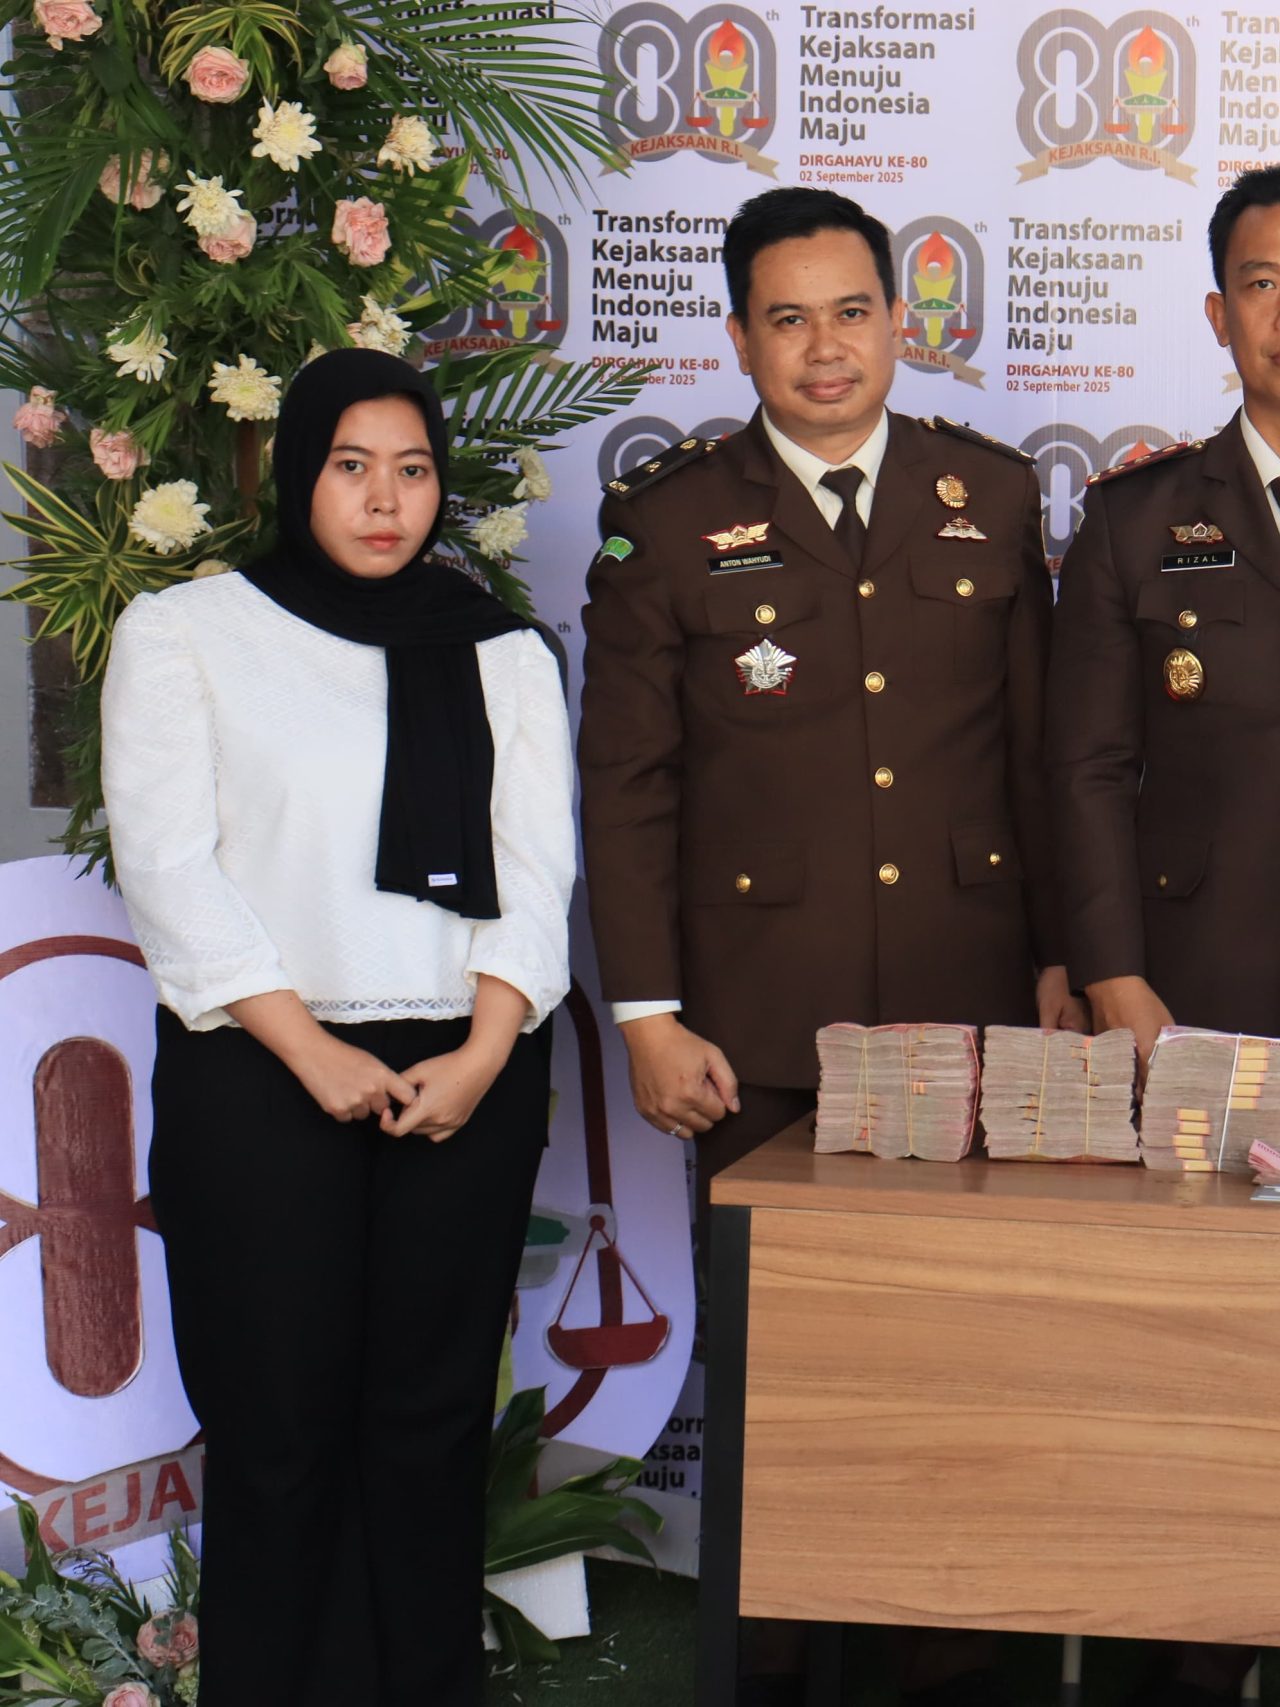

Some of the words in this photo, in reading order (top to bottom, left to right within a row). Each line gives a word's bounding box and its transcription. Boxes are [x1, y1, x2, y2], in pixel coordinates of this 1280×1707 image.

[766, 9, 779, 21] th
[800, 5, 974, 30] Transformasi
[1186, 16, 1199, 27] th
[800, 35, 934, 64] Kejaksaan
[800, 64, 900, 93] Menuju
[800, 90, 929, 114] Indonesia
[800, 117, 865, 146] Maju
[630, 135, 717, 156] KEJAKSAAN
[720, 140, 743, 158] R.I.
[1048, 141, 1135, 162] KEJAKSAAN
[1138, 146, 1162, 165] R.I.
[800, 155, 882, 167] DIRGAHAYU
[888, 156, 927, 168] KE-80
[800, 171, 812, 181] 02
[817, 171, 874, 184] September
[878, 172, 903, 183] 2025
[558, 214, 571, 225] th
[593, 210, 728, 234] Transform
[974, 222, 987, 233] th
[1009, 217, 1182, 241] Transformasi
[1008, 246, 1142, 275] Kejaksaan
[592, 267, 693, 293] Menuju
[1008, 275, 1108, 304] Menuju
[592, 293, 720, 317] Indonesia
[1008, 301, 1136, 324] Indonesia
[593, 320, 657, 349] Maju
[1007, 328, 1072, 356] Maju
[680, 359, 719, 370] KE-80
[929, 350, 951, 369] R.I.
[1007, 364, 1089, 377] DIRGAHAYU
[1094, 366, 1134, 377] KE-80
[669, 374, 695, 385] 2025
[1007, 380, 1019, 391] 02
[1023, 381, 1080, 394] September
[1084, 381, 1110, 392] 2025
[1179, 430, 1193, 441] th
[742, 556, 771, 565] WAHYUDI
[1178, 556, 1217, 564] RIZAL
[557, 622, 571, 633] th
